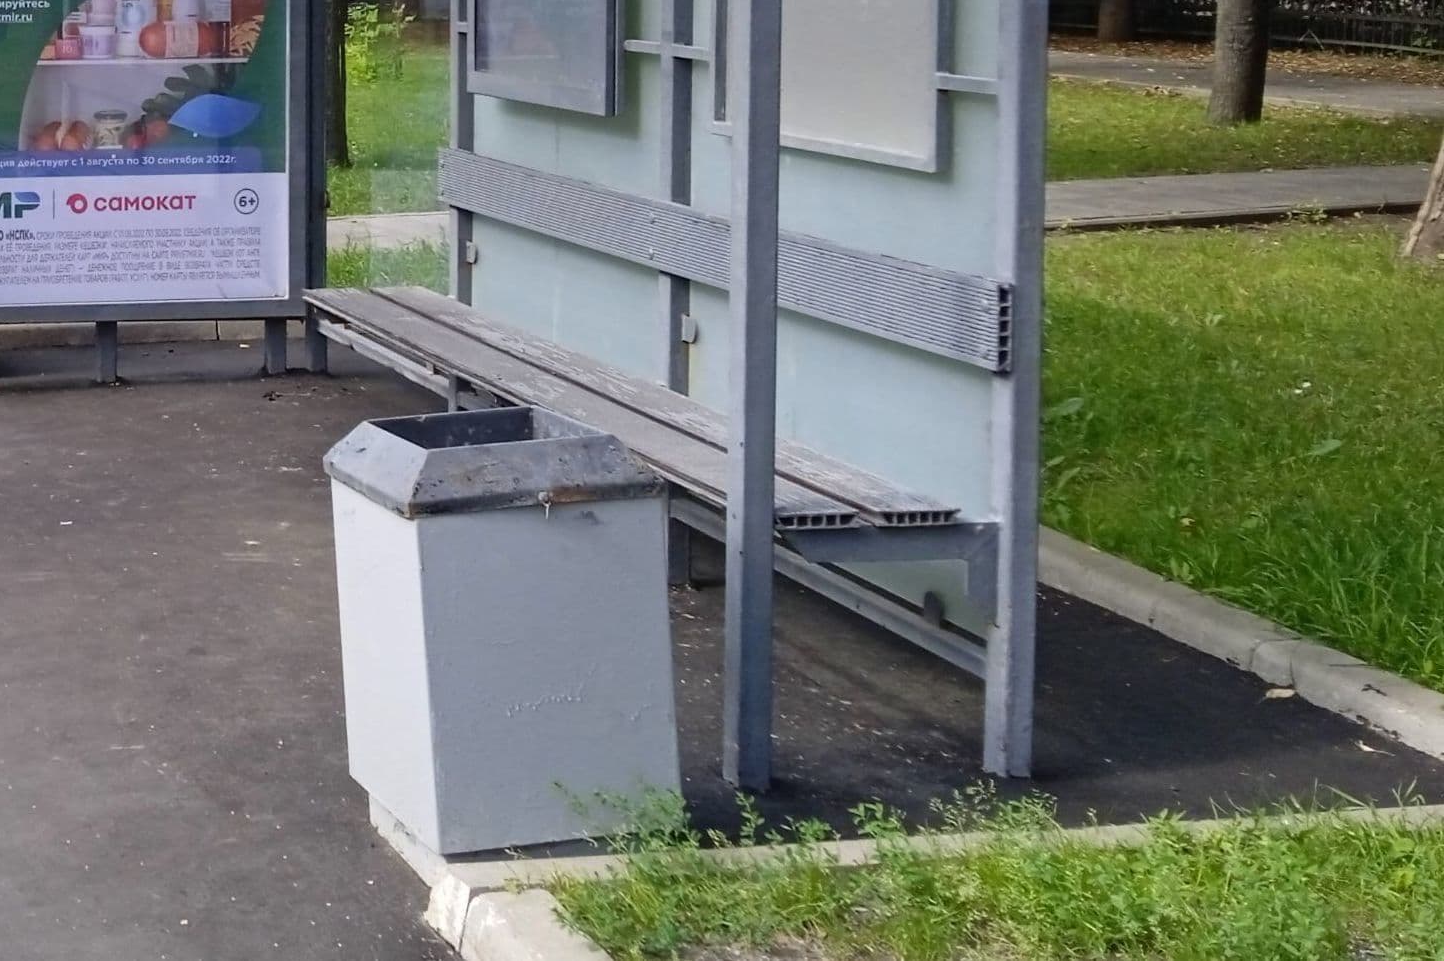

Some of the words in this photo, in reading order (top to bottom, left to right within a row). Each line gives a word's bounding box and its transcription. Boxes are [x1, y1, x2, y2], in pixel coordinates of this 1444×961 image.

[18, 158, 69, 169] действует
[87, 156, 124, 168] августа
[127, 158, 139, 166] по
[141, 156, 155, 165] 30
[157, 155, 204, 167] сентября
[93, 195, 196, 212] самокат
[238, 196, 256, 207] 6+
